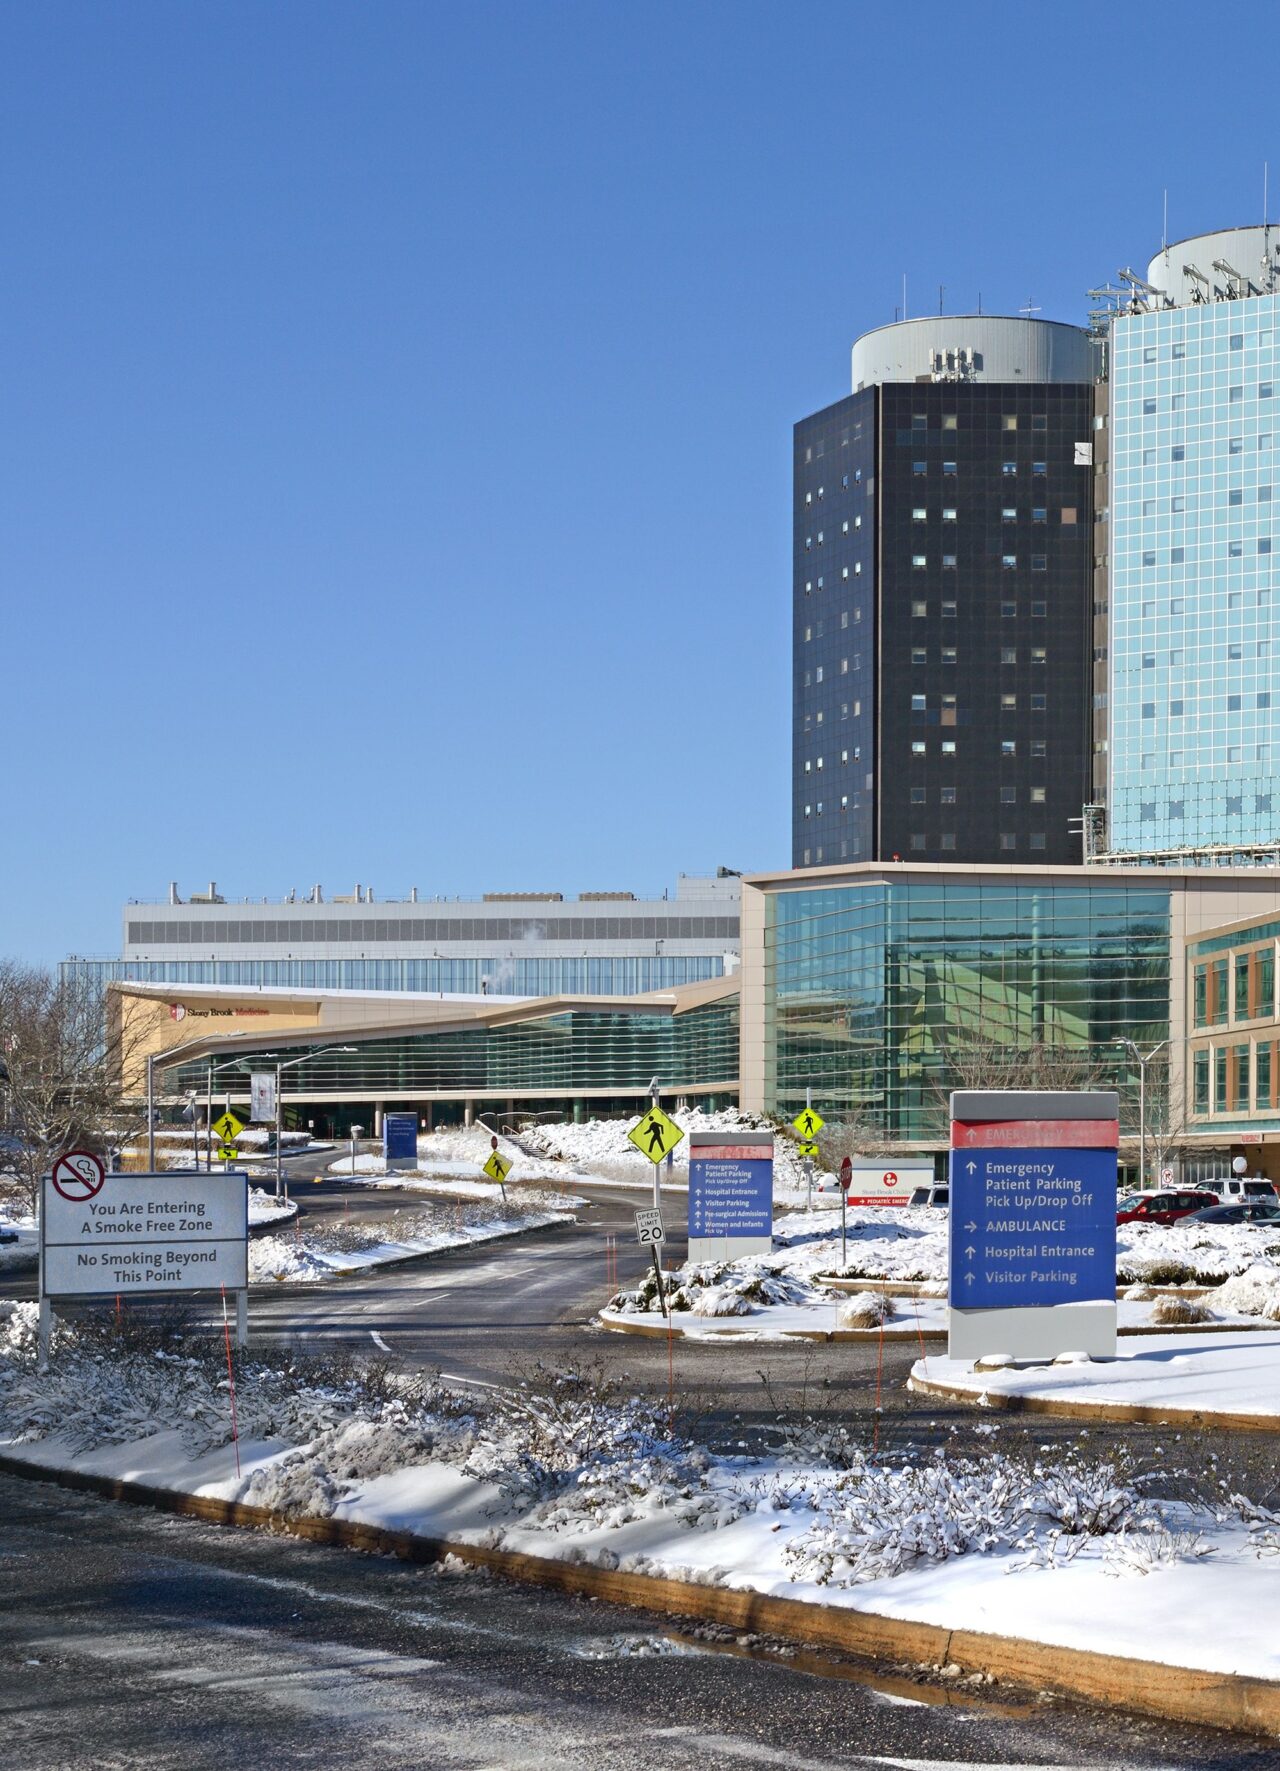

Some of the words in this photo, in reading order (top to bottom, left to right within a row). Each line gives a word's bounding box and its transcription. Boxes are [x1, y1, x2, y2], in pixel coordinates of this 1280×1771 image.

[210, 1008, 233, 1016] Brook
[986, 1162, 1055, 1177] Emergency
[705, 1188, 730, 1196] Hospital
[986, 1178, 1030, 1190] Patient
[1036, 1178, 1082, 1192] Parking
[726, 1200, 750, 1208] Parking
[986, 1195, 1010, 1207] Pick
[1015, 1194, 1067, 1209] Up/Drop
[1072, 1193, 1093, 1206] Off
[89, 1203, 116, 1215] You
[120, 1202, 143, 1215] Are
[147, 1201, 206, 1216] Entering
[704, 1210, 736, 1219] Pre-surgical
[638, 1212, 660, 1220] SPEED
[81, 1222, 92, 1234] A
[95, 1220, 143, 1233] Smoke
[146, 1220, 175, 1232] Free
[179, 1219, 213, 1231] Zone
[986, 1219, 1066, 1232] AMBULANCE
[640, 1227, 662, 1242] 20
[78, 1254, 97, 1266] No
[101, 1251, 162, 1267] Smoking
[166, 1250, 217, 1267] Beyond
[985, 1245, 1037, 1260] Hospital
[1041, 1245, 1095, 1256] Entrance
[114, 1270, 142, 1283] This
[146, 1269, 182, 1281] Point
[985, 1271, 1027, 1283] Visitor
[1031, 1270, 1077, 1285] Parking
